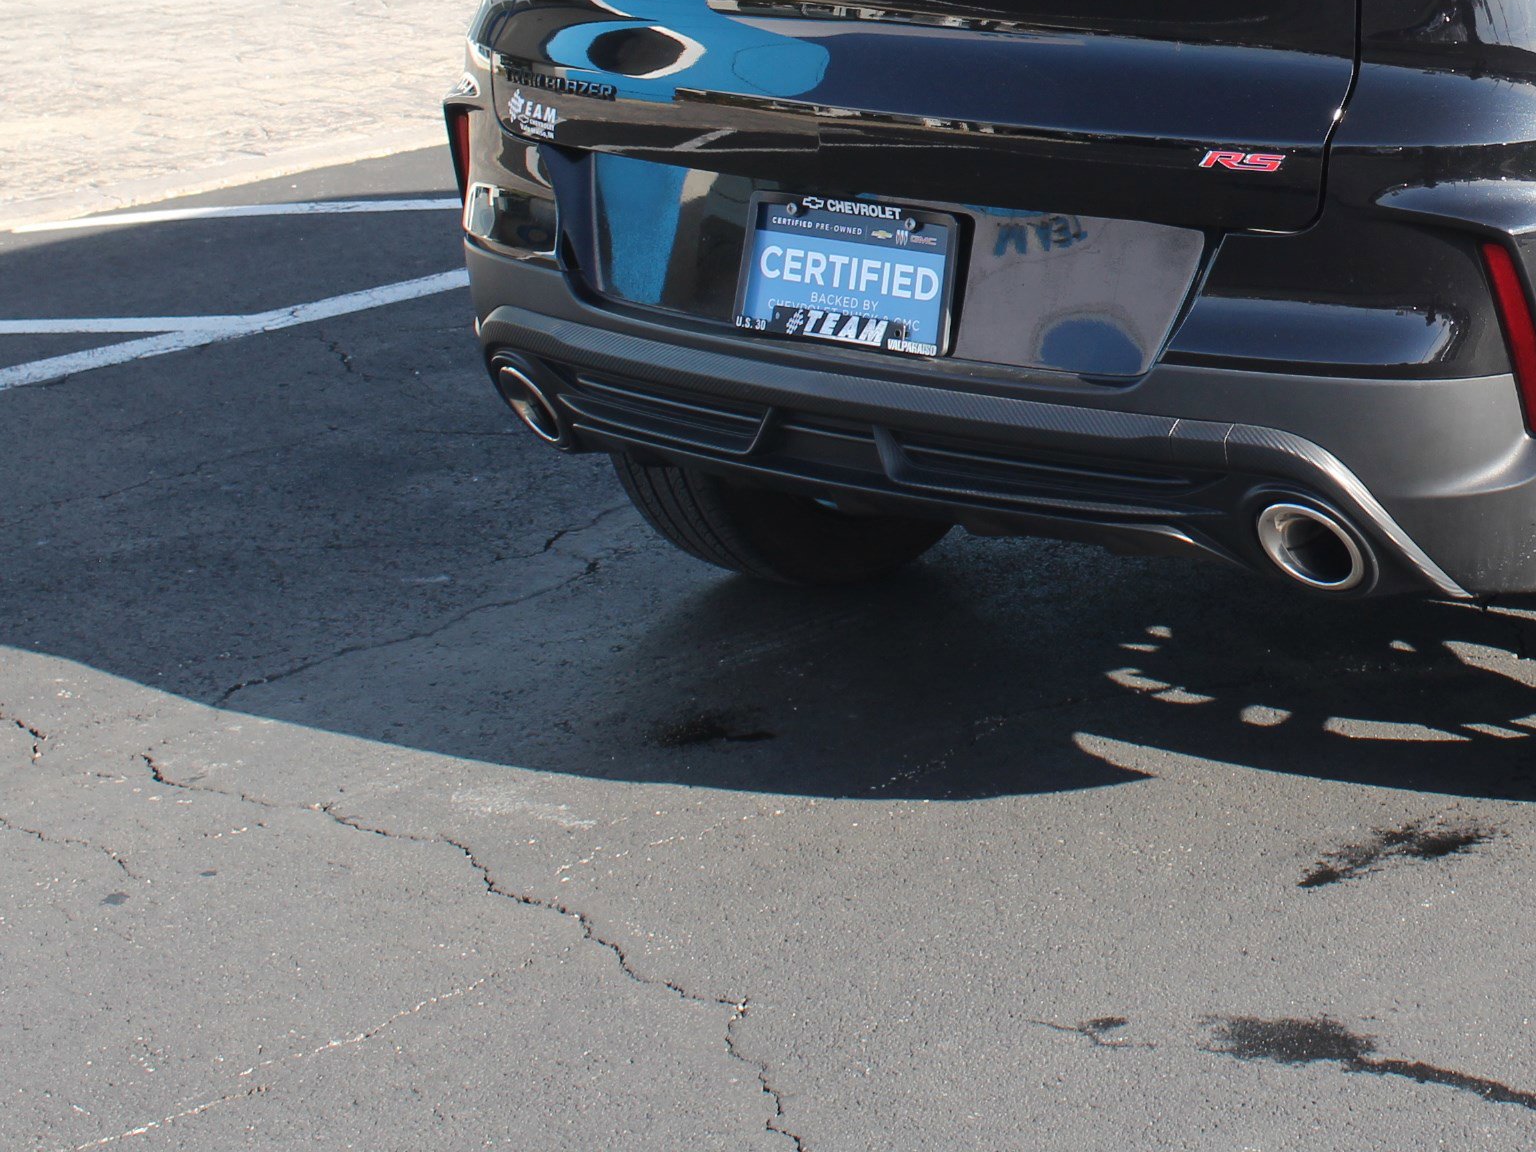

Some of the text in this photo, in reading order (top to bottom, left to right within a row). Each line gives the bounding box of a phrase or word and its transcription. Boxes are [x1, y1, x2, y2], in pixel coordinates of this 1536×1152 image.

[1199, 150, 1286, 172] RS
[826, 199, 902, 220] CHEVROLET
[772, 216, 863, 236] CERTIFIED PRE-OWNED
[909, 234, 938, 246] GMC
[760, 246, 940, 301] CERTIFIED
[810, 291, 880, 311] BACKED BY
[735, 315, 767, 331] U.S. 30
[803, 309, 888, 343] TEAM
[887, 338, 938, 357] VALPARAISO
